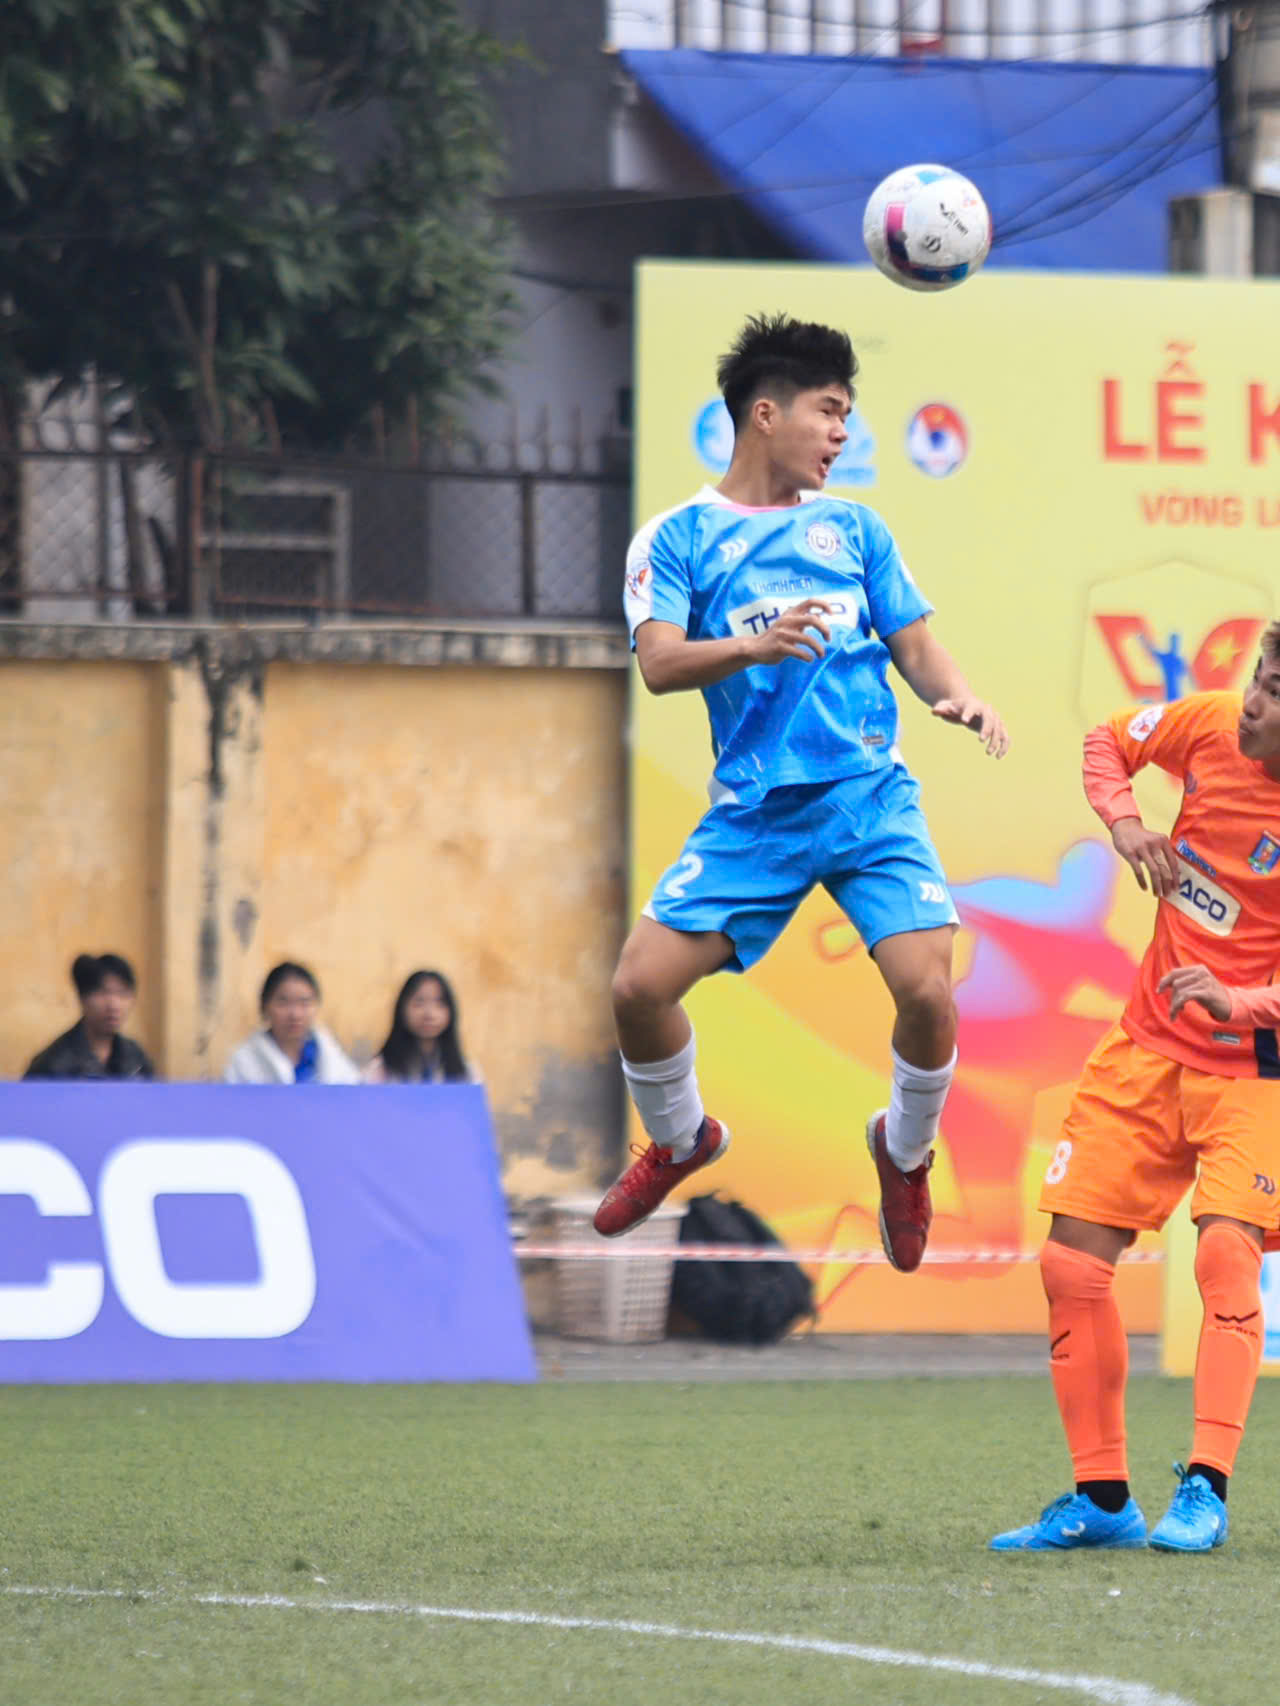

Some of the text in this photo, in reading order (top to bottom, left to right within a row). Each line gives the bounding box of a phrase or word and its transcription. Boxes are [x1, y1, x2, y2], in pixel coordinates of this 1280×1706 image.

[1101, 340, 1206, 463] LỄ
[664, 853, 703, 898] 2
[1179, 878, 1228, 922] ACO
